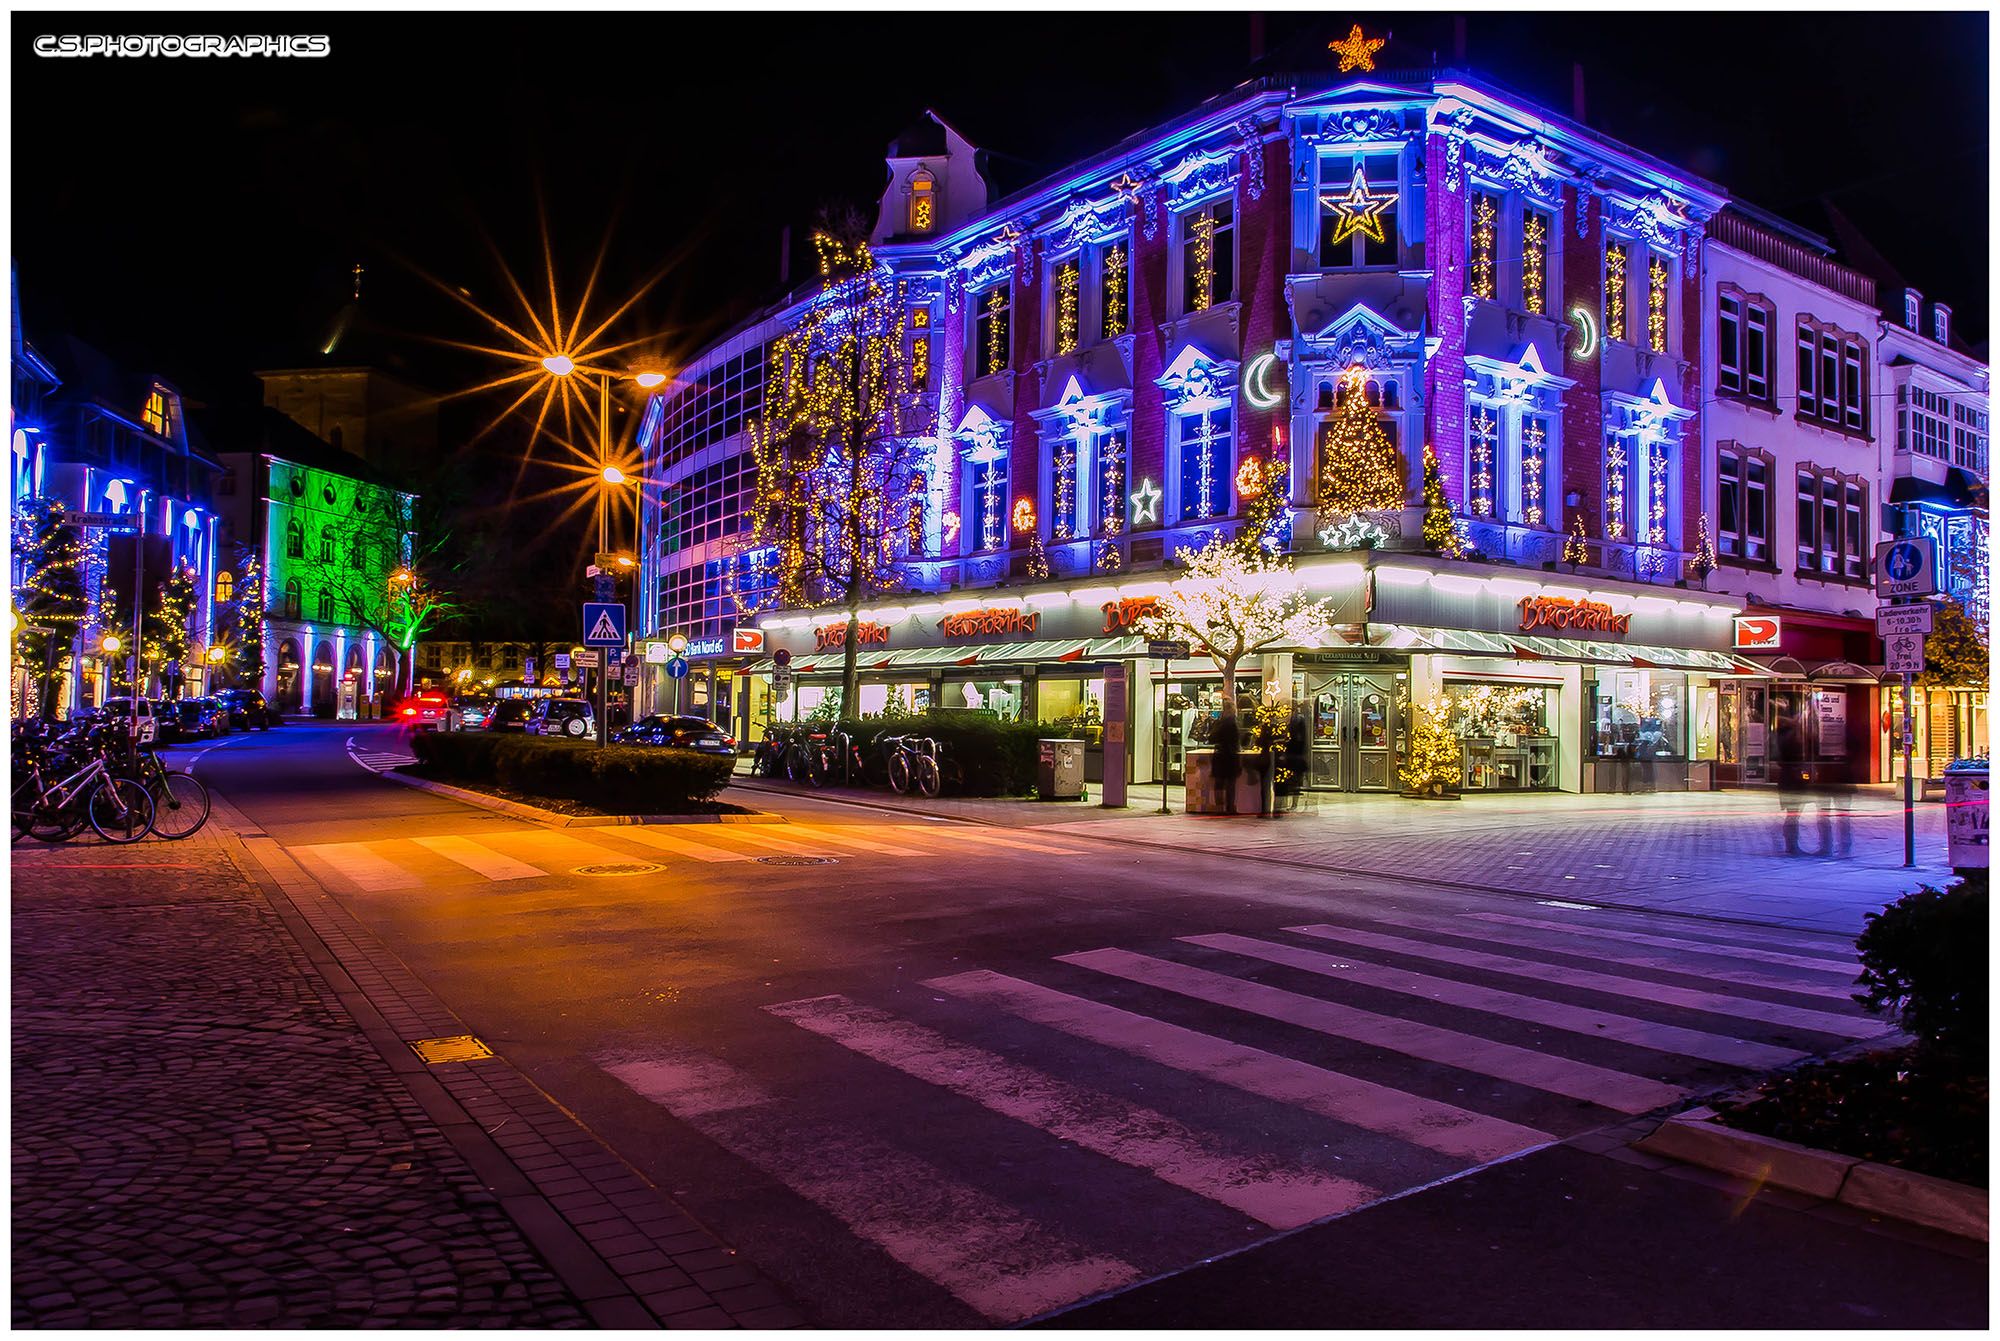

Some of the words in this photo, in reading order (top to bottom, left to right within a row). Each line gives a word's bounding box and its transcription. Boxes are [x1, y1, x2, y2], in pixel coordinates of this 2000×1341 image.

[1890, 582, 1919, 593] ZONE
[1879, 606, 1929, 618] Ladeverkehr
[1897, 651, 1912, 660] frei
